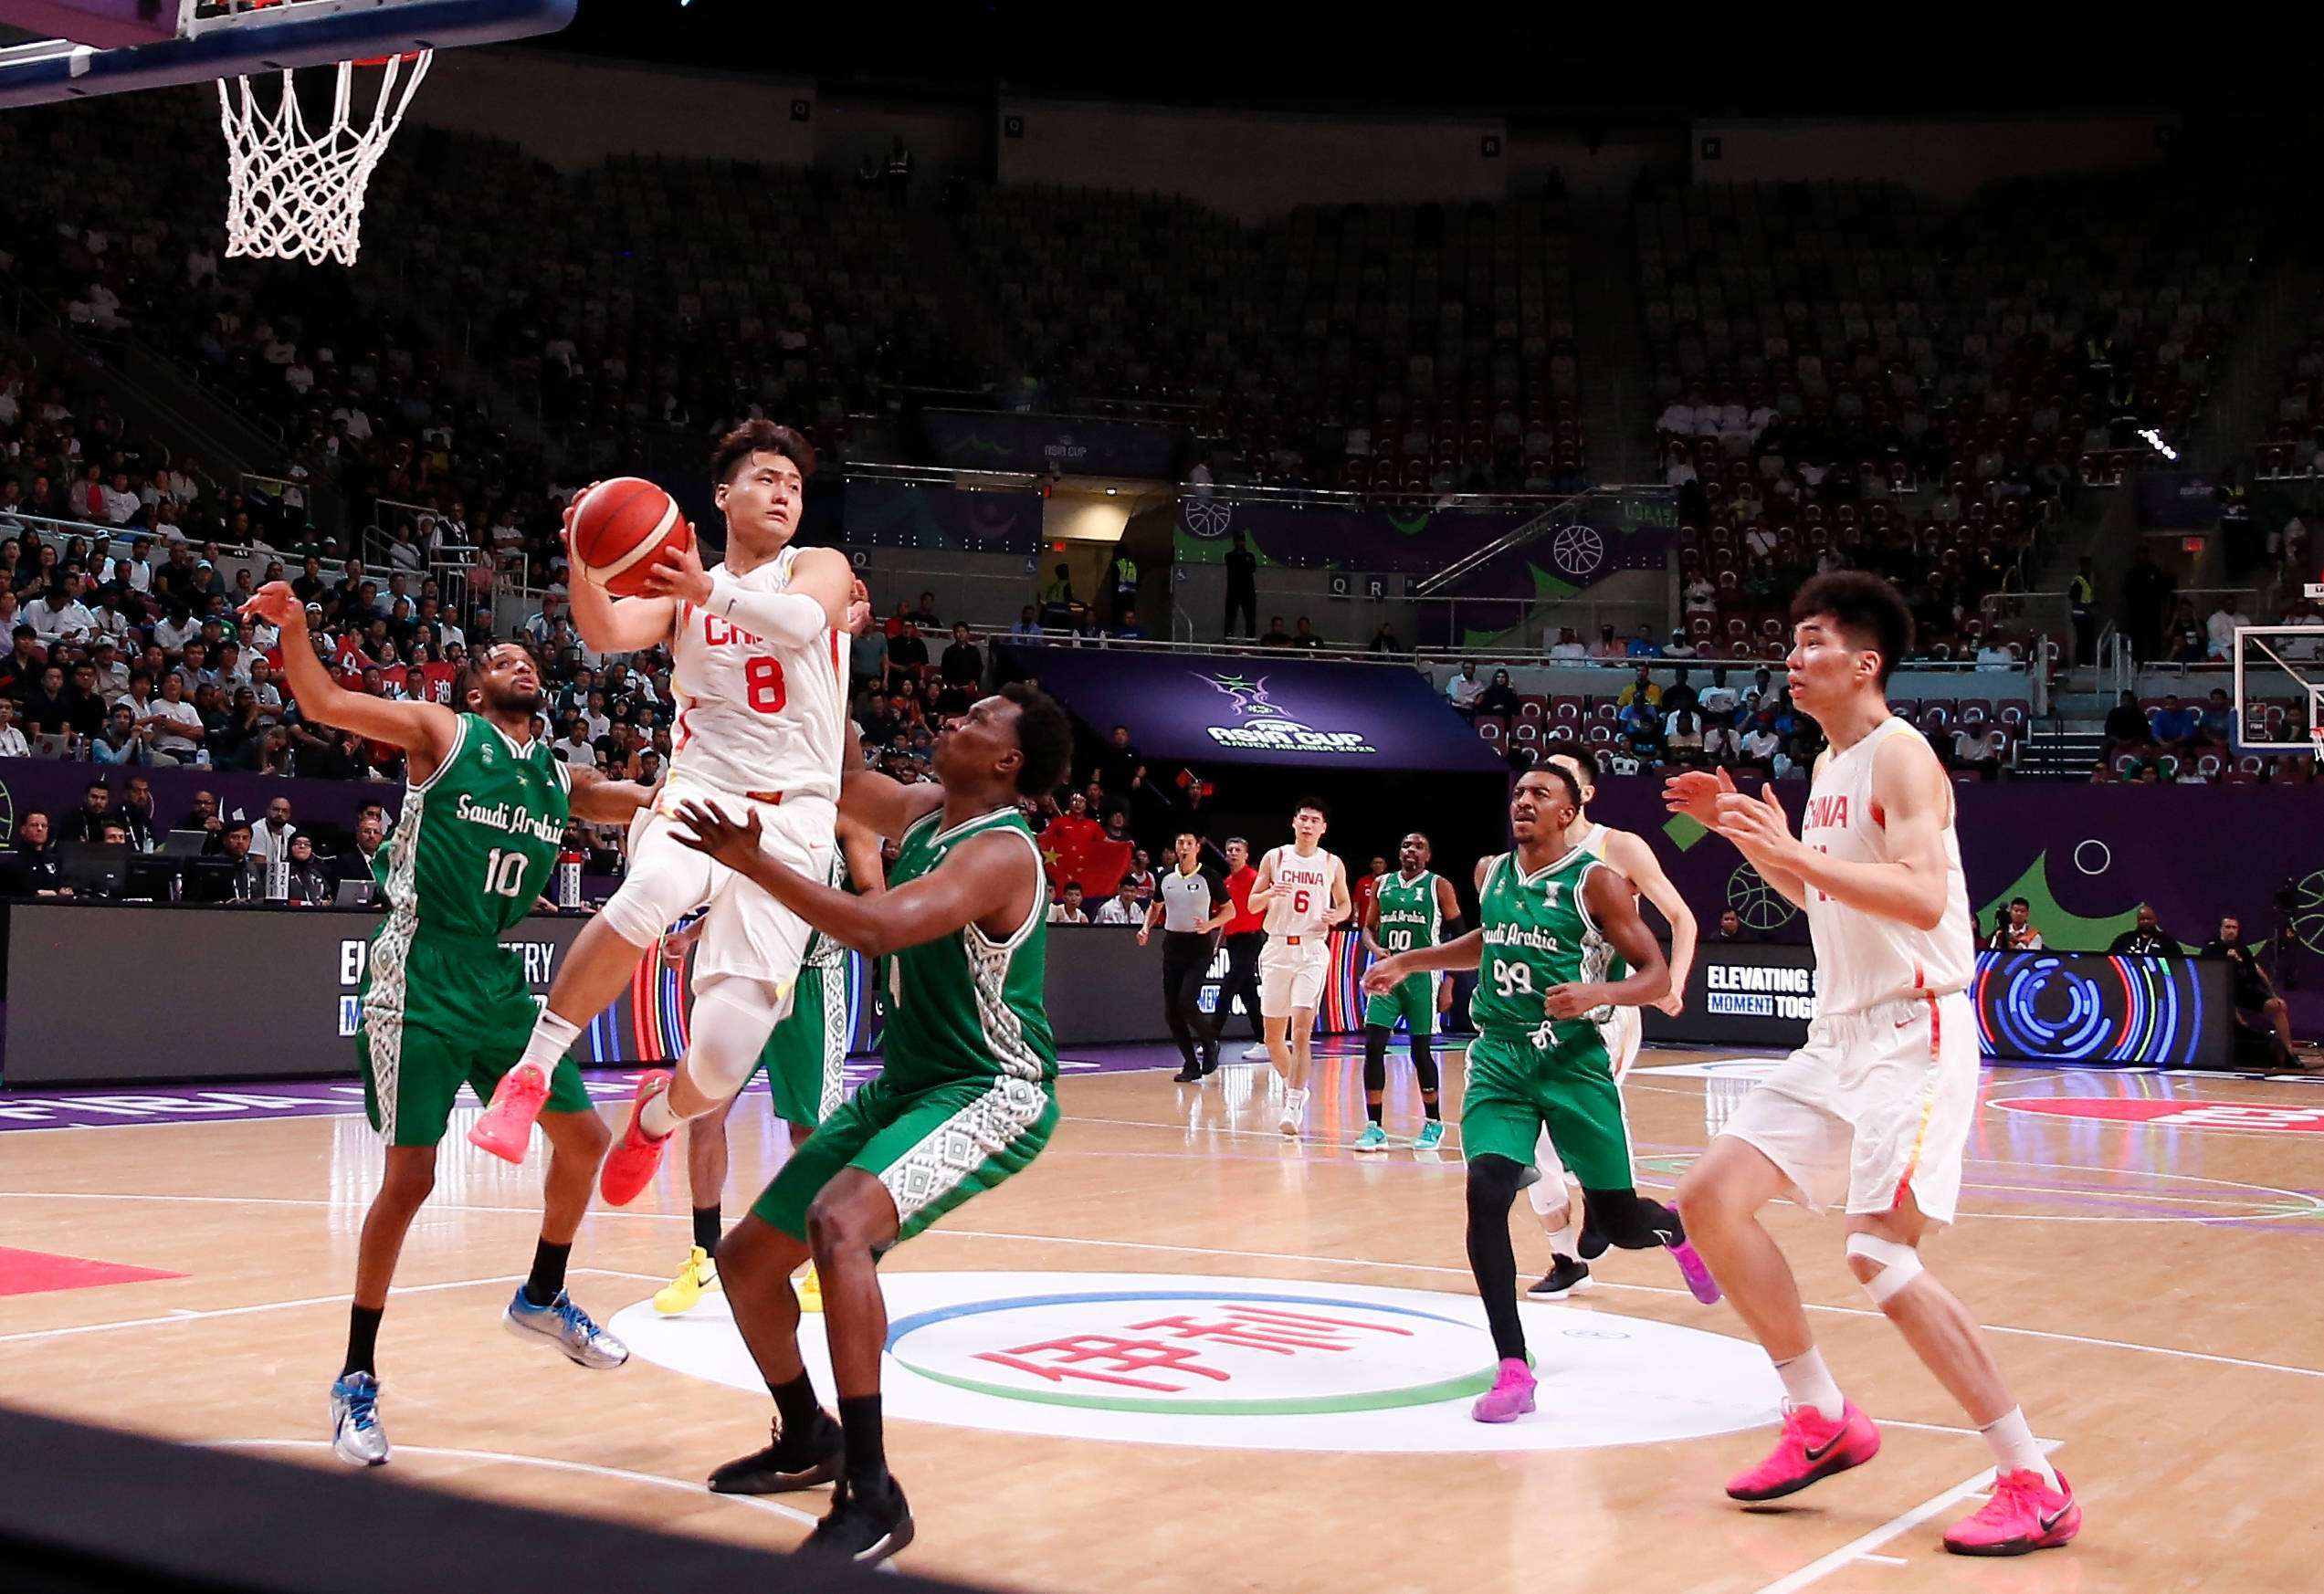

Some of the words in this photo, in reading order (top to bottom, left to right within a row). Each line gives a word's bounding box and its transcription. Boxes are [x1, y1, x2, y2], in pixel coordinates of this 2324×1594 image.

[1333, 578, 1346, 595] Q
[1371, 581, 1382, 596] R
[745, 655, 787, 714] 8
[1207, 727, 1294, 745] ASIA
[1294, 731, 1364, 747] CUP
[1219, 739, 1271, 750] SAUDI
[457, 793, 509, 830] Saudi
[483, 847, 530, 897] 10
[1281, 869, 1324, 886] CHINA
[1293, 889, 1310, 914] 6
[1388, 929, 1412, 951] 00
[1482, 921, 1505, 944] udi
[1504, 922, 1559, 951] Arabia
[1493, 958, 1533, 997] 99
[1708, 965, 1808, 992] ELEVATING
[1711, 993, 1772, 1013] MOMENT
